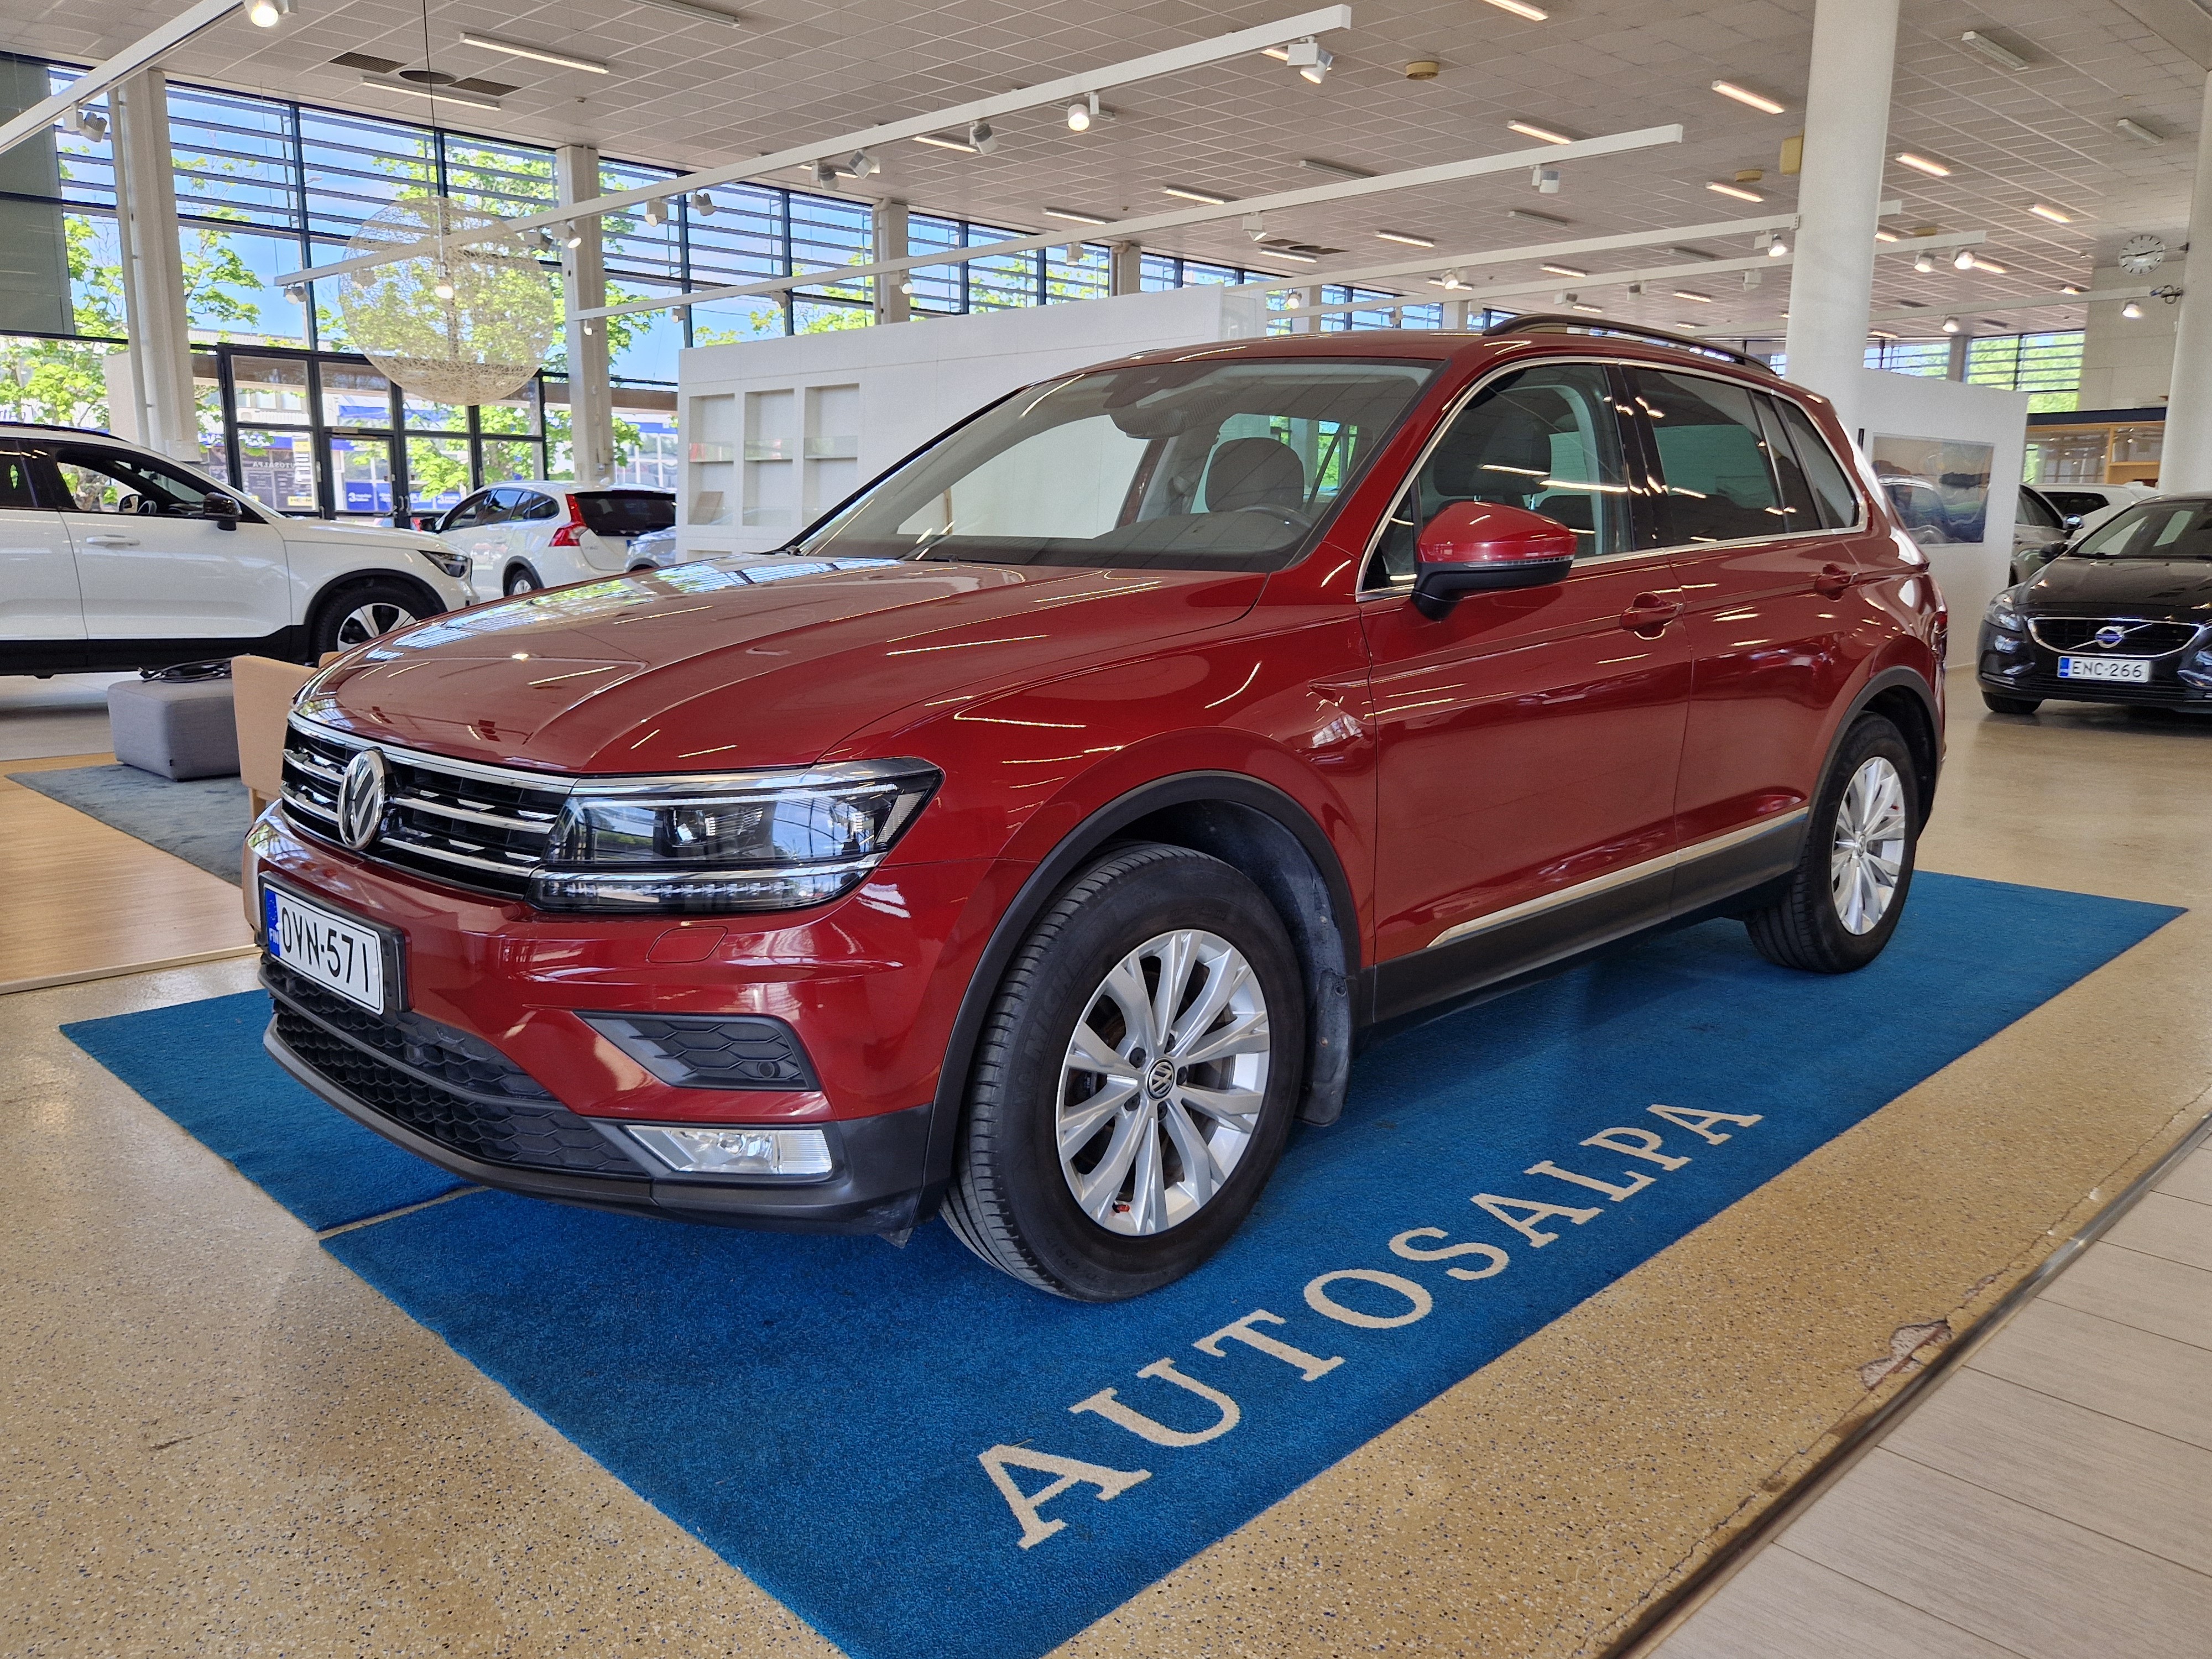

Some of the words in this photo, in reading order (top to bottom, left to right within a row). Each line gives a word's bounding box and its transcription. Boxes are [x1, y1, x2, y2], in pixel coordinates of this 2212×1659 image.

[2072, 661, 2142, 677] ENC-266
[269, 927, 279, 945] FIN
[281, 907, 369, 993] OVN-571
[978, 1104, 1763, 1550] AUTOSALPA
